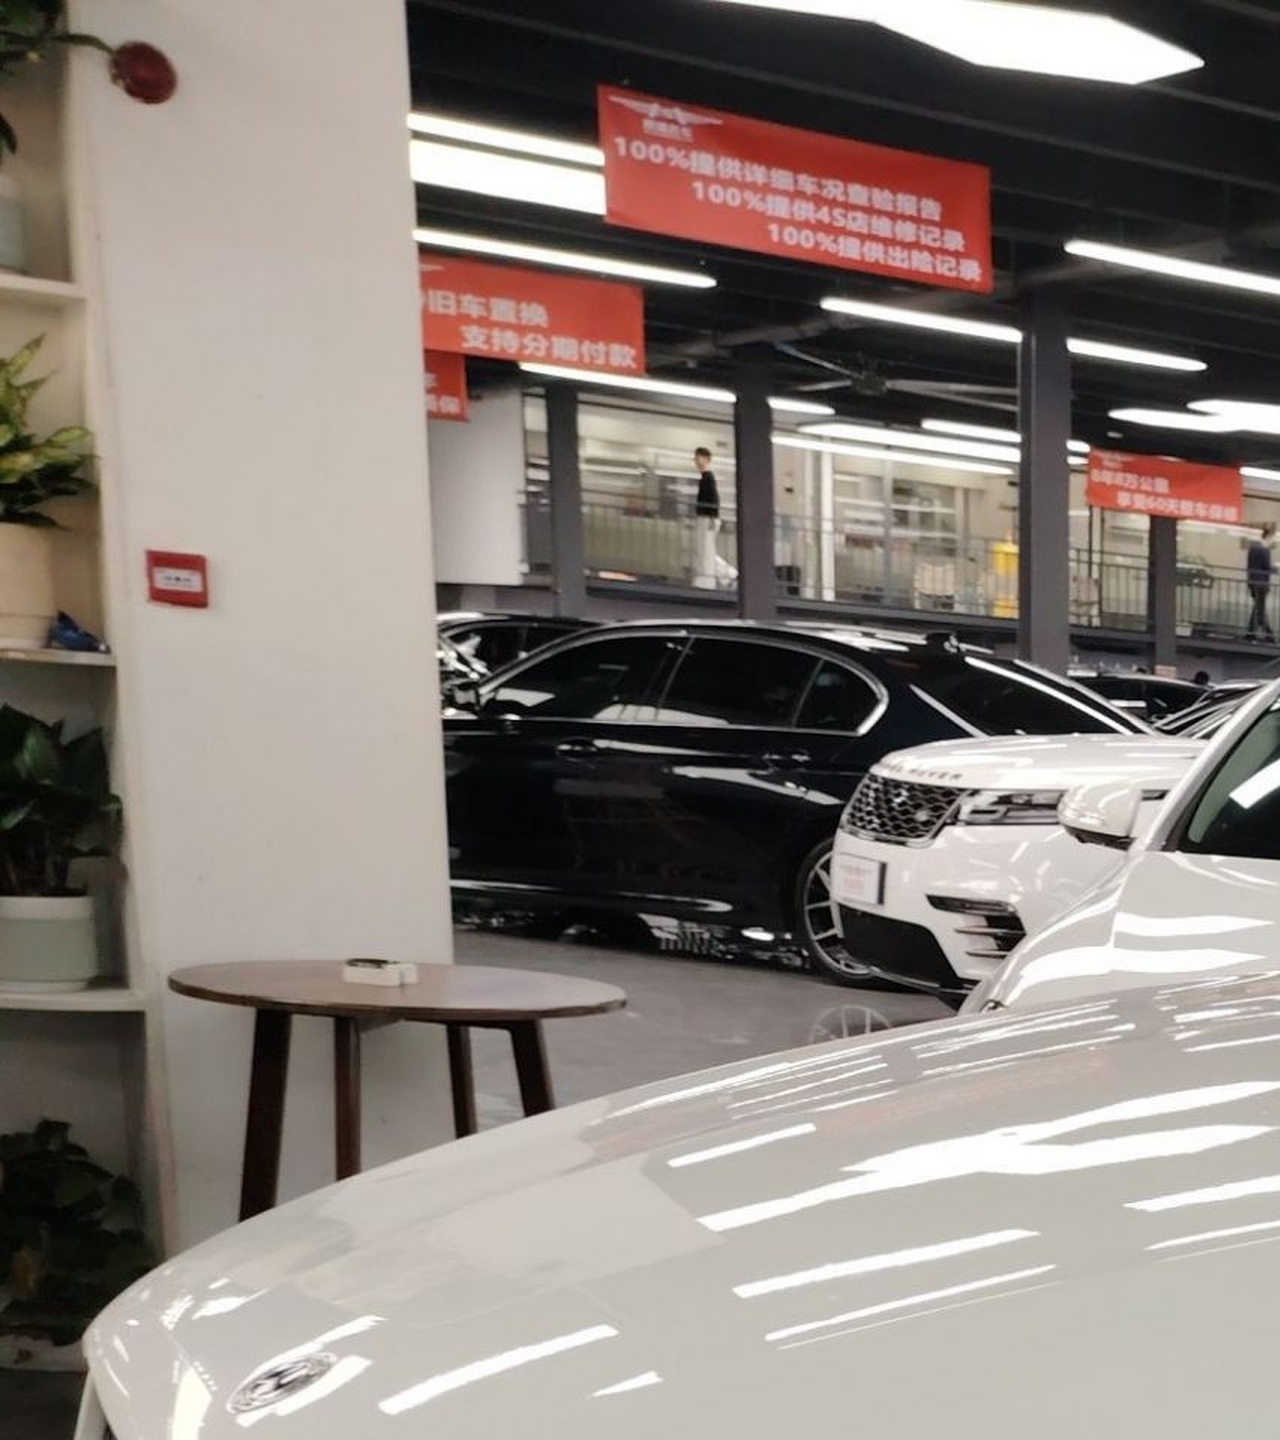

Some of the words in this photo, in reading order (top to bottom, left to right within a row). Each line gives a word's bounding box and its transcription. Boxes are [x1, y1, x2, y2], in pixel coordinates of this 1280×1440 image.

[767, 223, 982, 281] 100%提供出险记录
[460, 325, 637, 368] 支持分期付款
